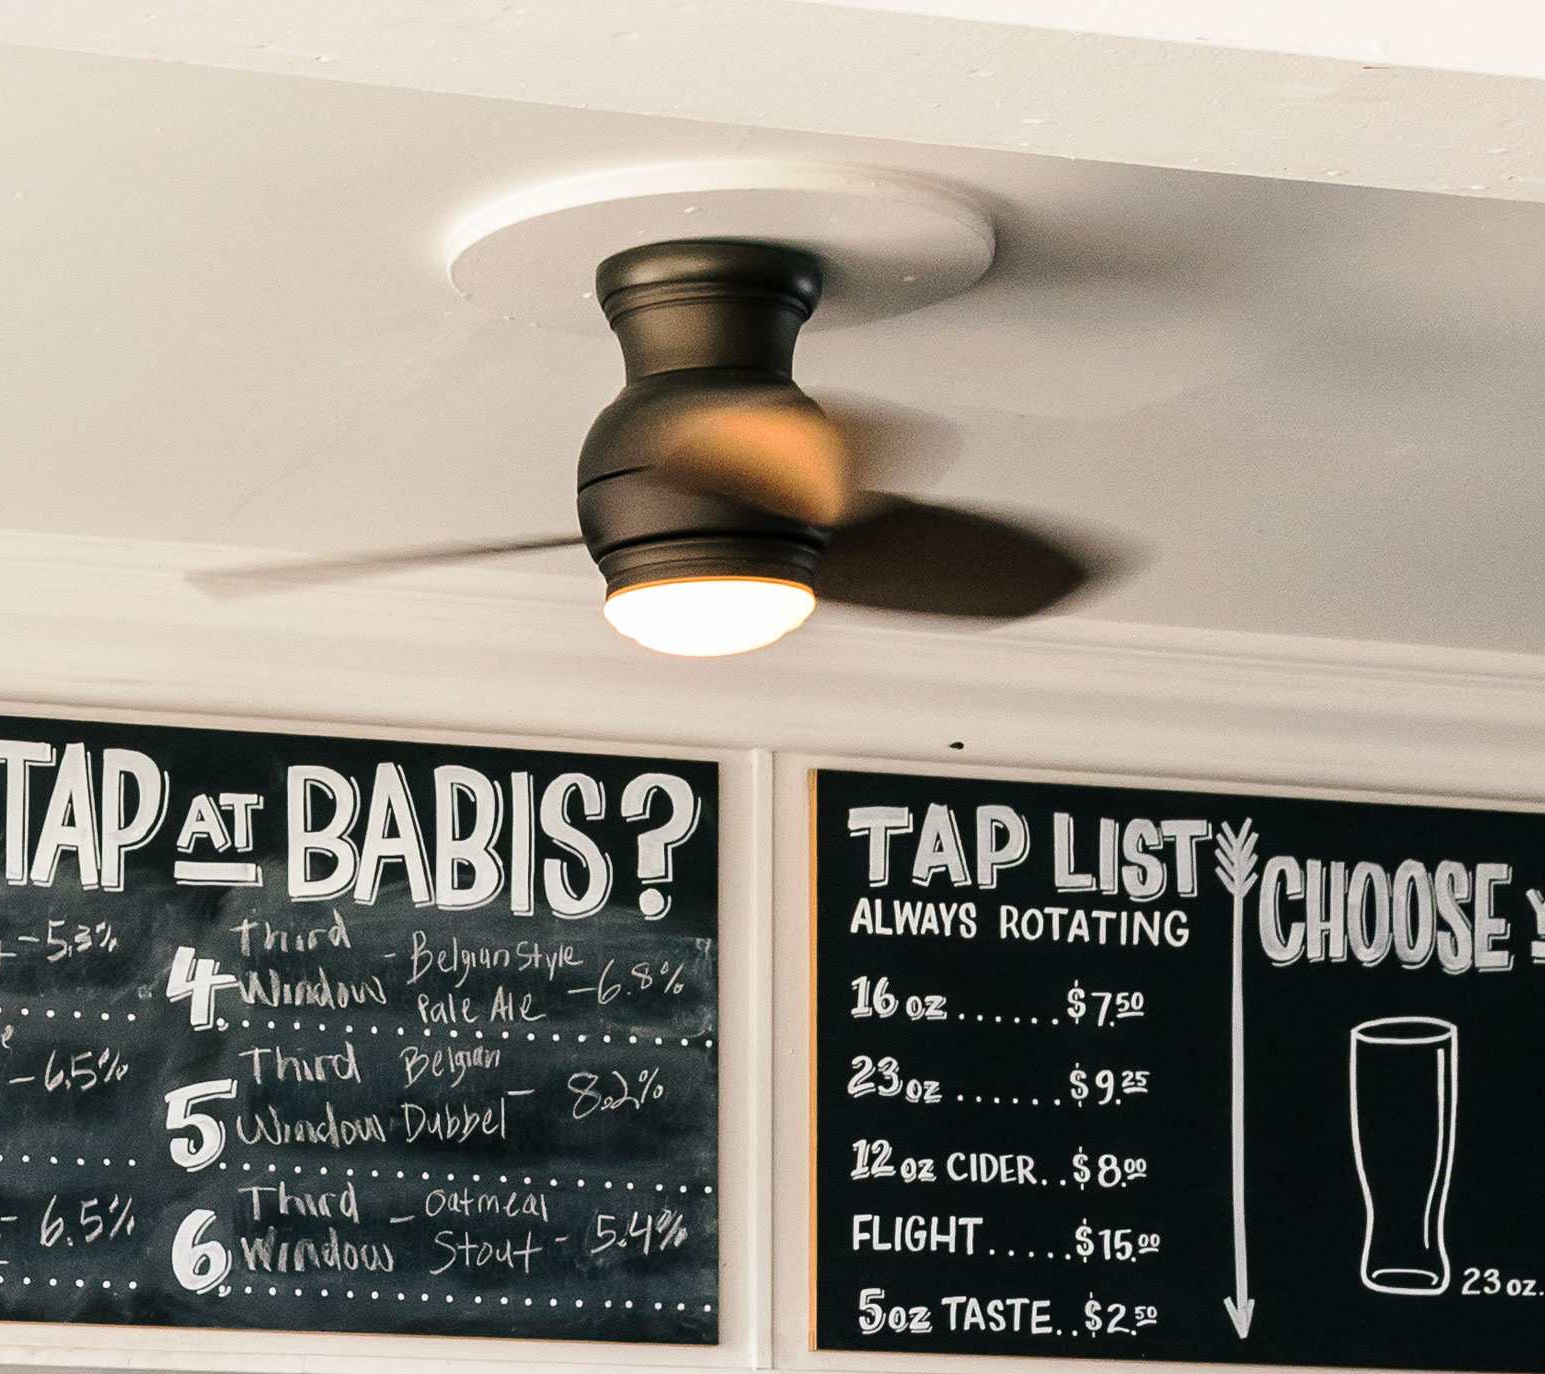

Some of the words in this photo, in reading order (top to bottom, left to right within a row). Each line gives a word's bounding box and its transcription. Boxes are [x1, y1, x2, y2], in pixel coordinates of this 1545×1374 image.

[177, 793, 262, 853] AT
[287, 763, 701, 919] BABIS?
[848, 803, 1030, 889] TAP
[1052, 812, 1212, 902] LIST
[850, 899, 976, 939] ALWAYS
[1000, 905, 1190, 947] ROTATING
[1259, 855, 1513, 976] CHOOSE
[166, 946, 236, 1031] 4
[233, 968, 387, 1009] Window
[489, 986, 547, 1023] Ale
[239, 1042, 361, 1084] Third
[398, 1045, 501, 1088] Belgian
[165, 1079, 237, 1172] 5
[236, 1102, 386, 1147] Window
[401, 1098, 506, 1144] Dubbel
[946, 1152, 1038, 1186] CIDER
[239, 1182, 360, 1223] Third
[424, 1189, 548, 1221] Oatmeal
[171, 1209, 232, 1295] 6
[241, 1226, 393, 1274] Window
[430, 1230, 543, 1275] Stout
[852, 1214, 983, 1256] FLIGHT
[942, 1296, 1054, 1334] TASTE
